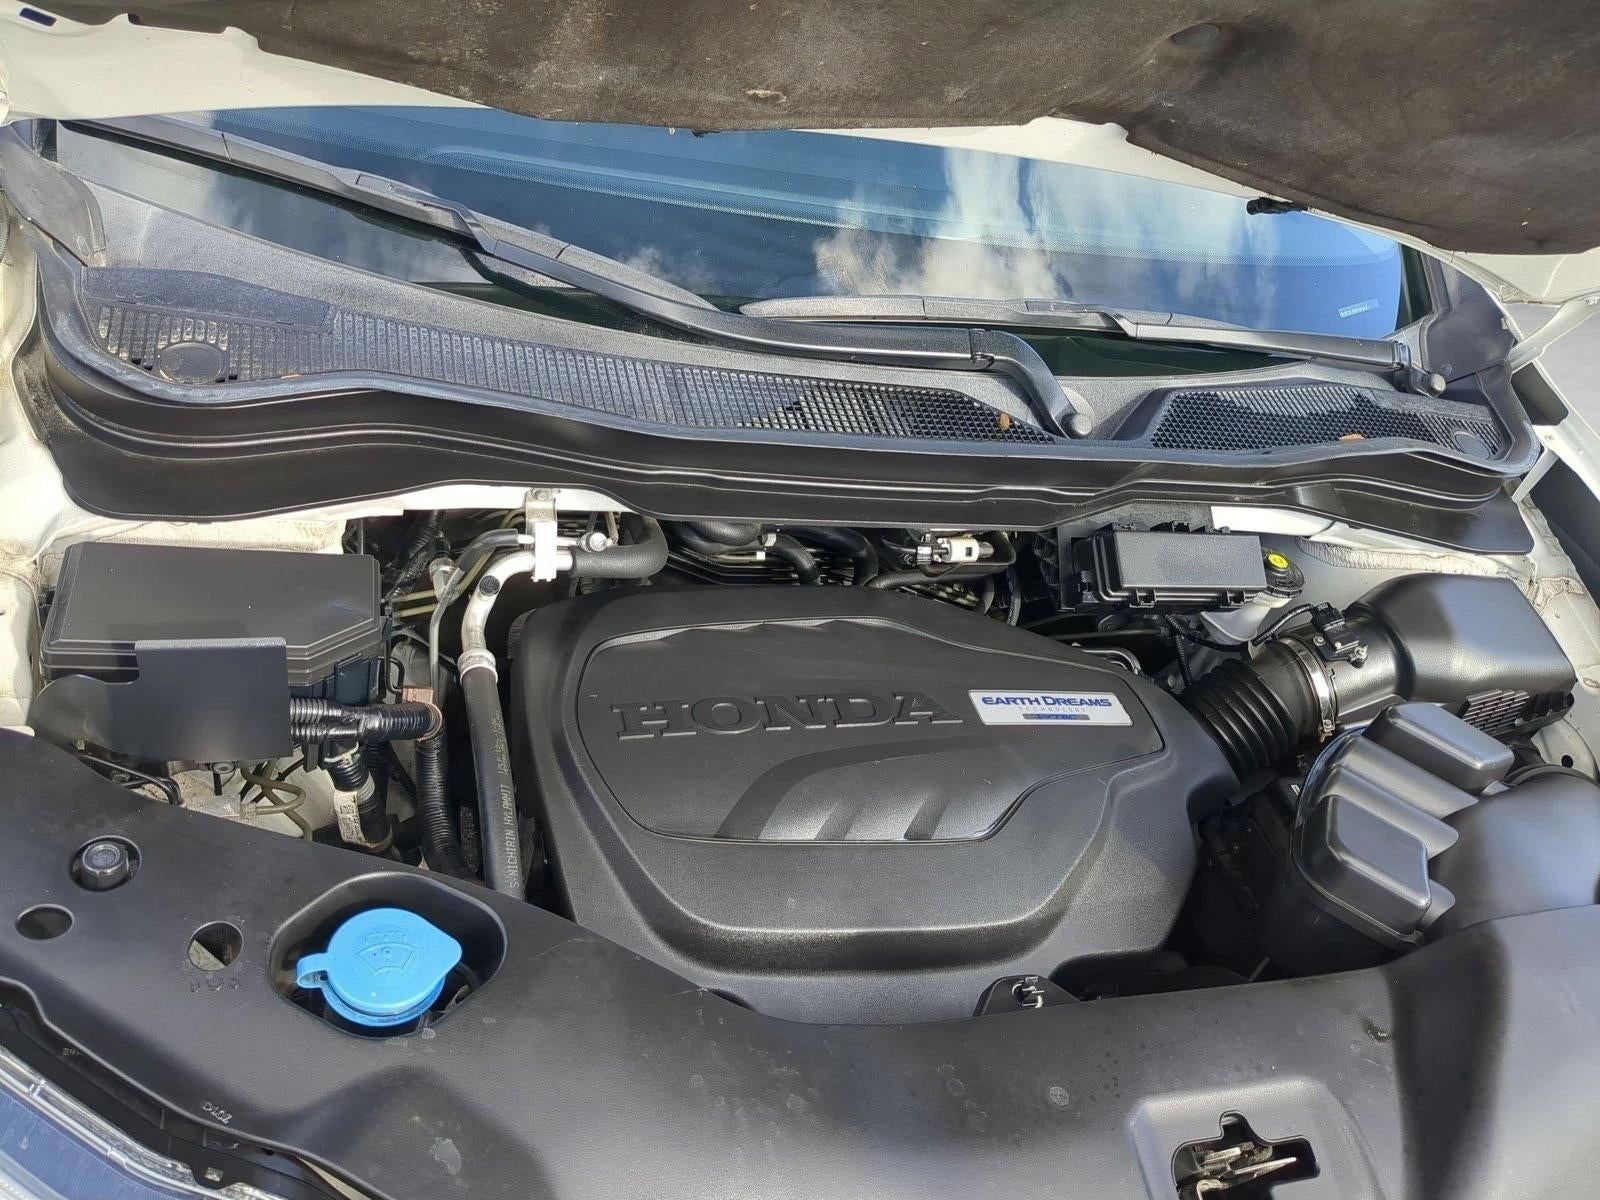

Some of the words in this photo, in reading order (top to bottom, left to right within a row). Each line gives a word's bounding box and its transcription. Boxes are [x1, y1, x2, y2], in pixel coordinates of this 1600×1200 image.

[611, 692, 963, 741] HONDA
[981, 696, 1039, 706] EARTH
[1041, 696, 1112, 707] DREAMS
